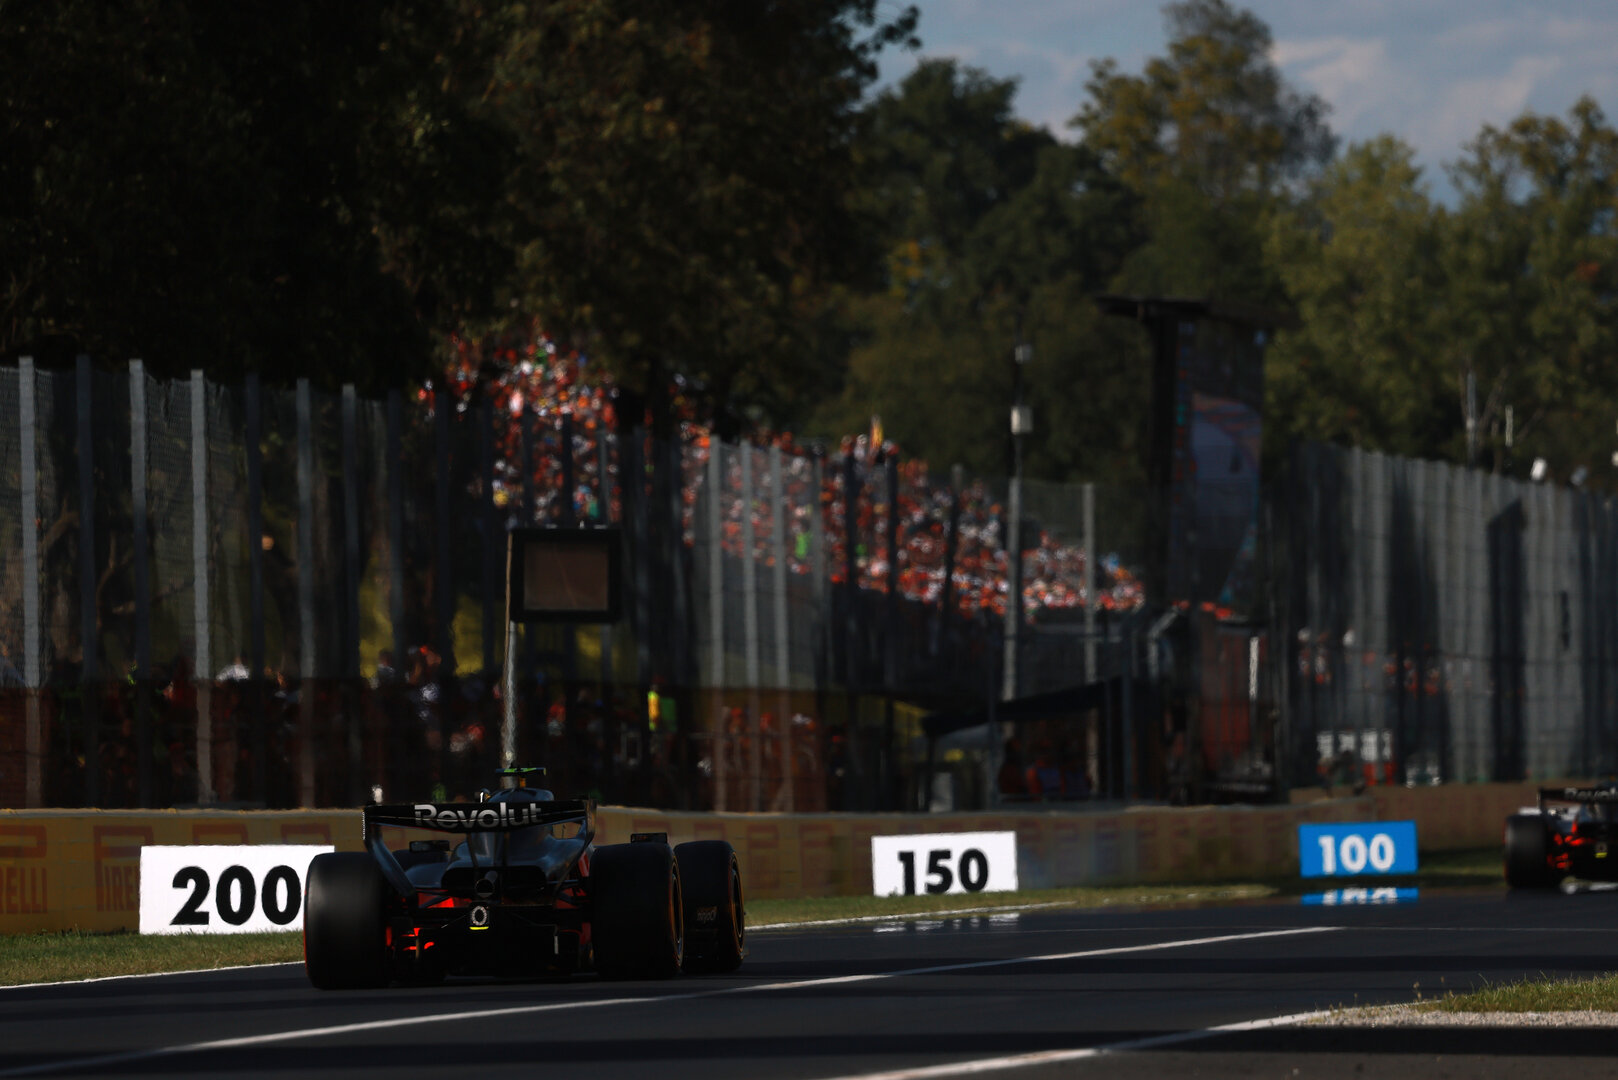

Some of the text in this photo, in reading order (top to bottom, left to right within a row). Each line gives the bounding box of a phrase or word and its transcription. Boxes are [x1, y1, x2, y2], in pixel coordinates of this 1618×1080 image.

[413, 802, 544, 829] Revolut
[899, 849, 988, 896] 150
[1319, 834, 1396, 874] 100
[170, 865, 302, 926] 200
